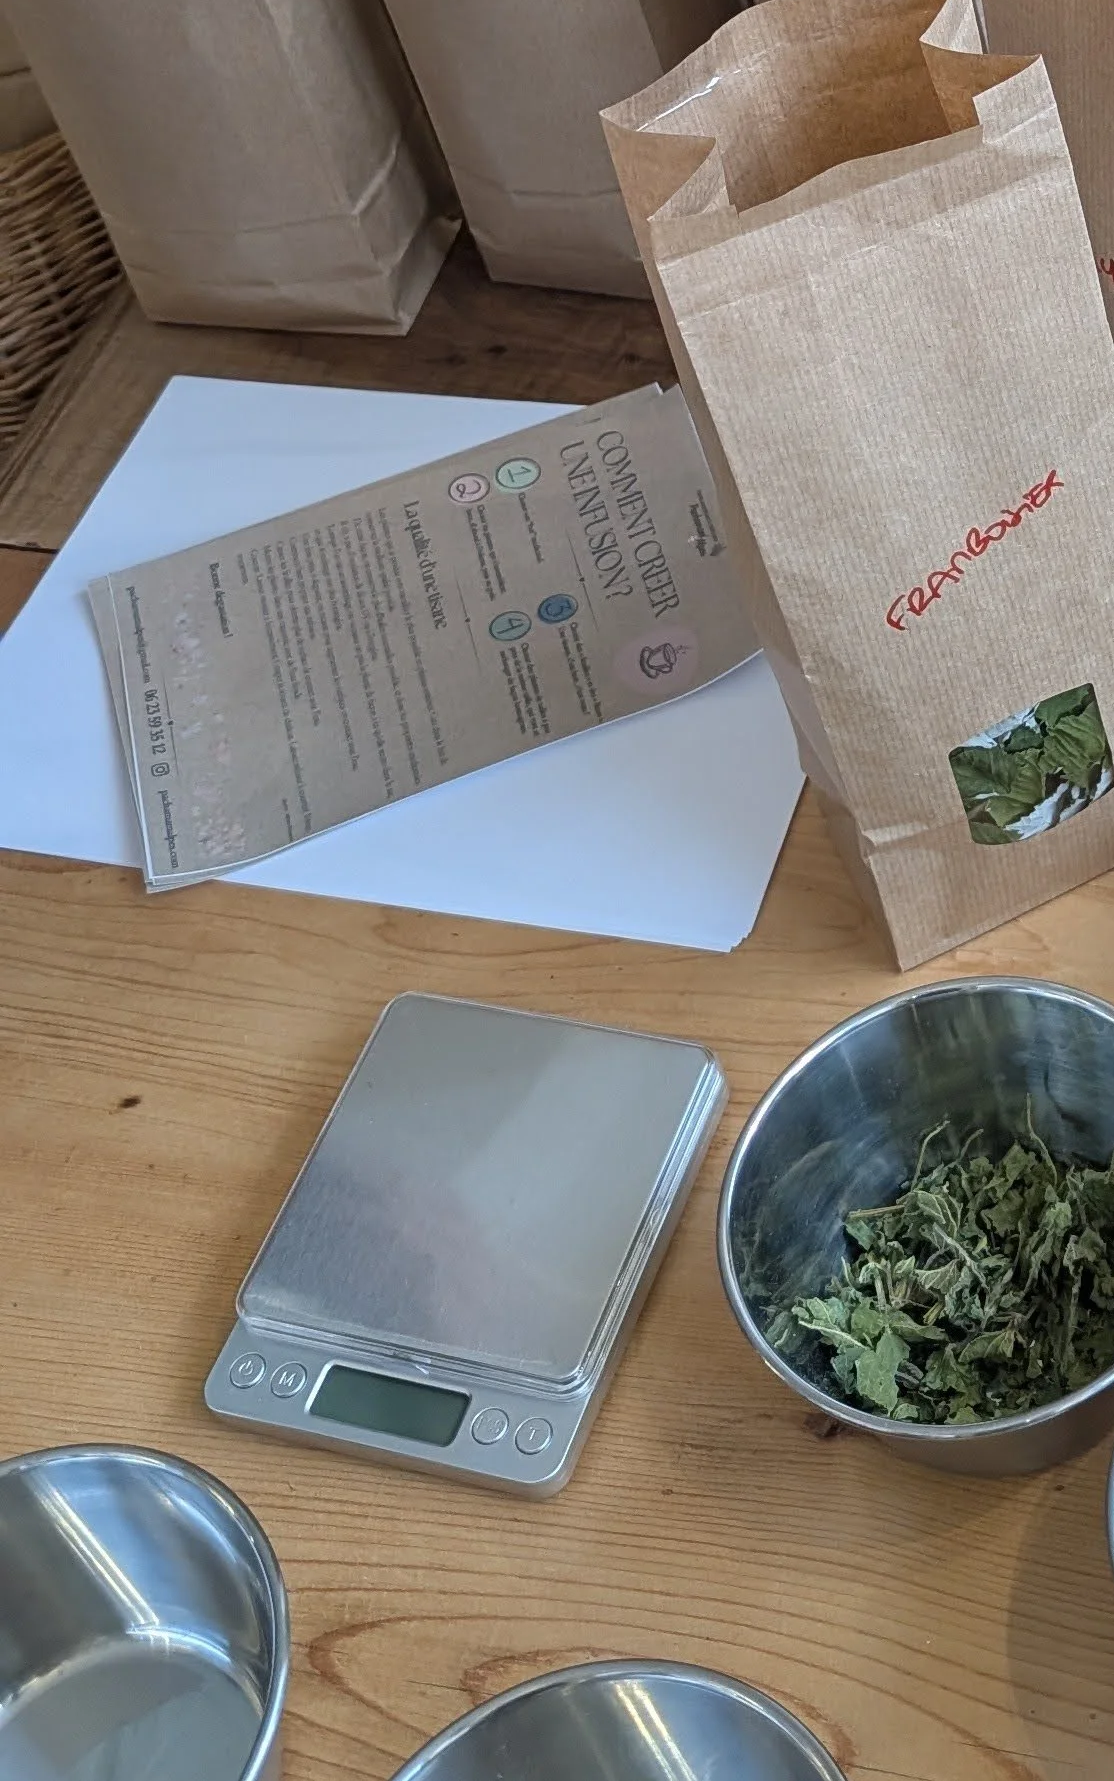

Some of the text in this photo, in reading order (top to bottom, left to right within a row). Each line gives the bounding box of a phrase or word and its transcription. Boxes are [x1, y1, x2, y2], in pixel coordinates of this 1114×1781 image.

[506, 463, 533, 483] 1
[558, 438, 597, 492] UNE
[454, 478, 482, 499] 2
[402, 499, 423, 521] La
[593, 426, 681, 619] COMMENT CREER
[403, 517, 433, 560] qualité
[573, 484, 629, 590] INFUSION
[425, 591, 450, 630] tisane
[543, 598, 573, 619] 3
[493, 615, 523, 634] 4
[142, 688, 158, 702] 06
[144, 702, 160, 715] 23
[146, 715, 162, 728] 59
[148, 729, 164, 742] 35
[150, 742, 166, 755] 12
[278, 1370, 295, 1388] M
[527, 1425, 541, 1441] T
